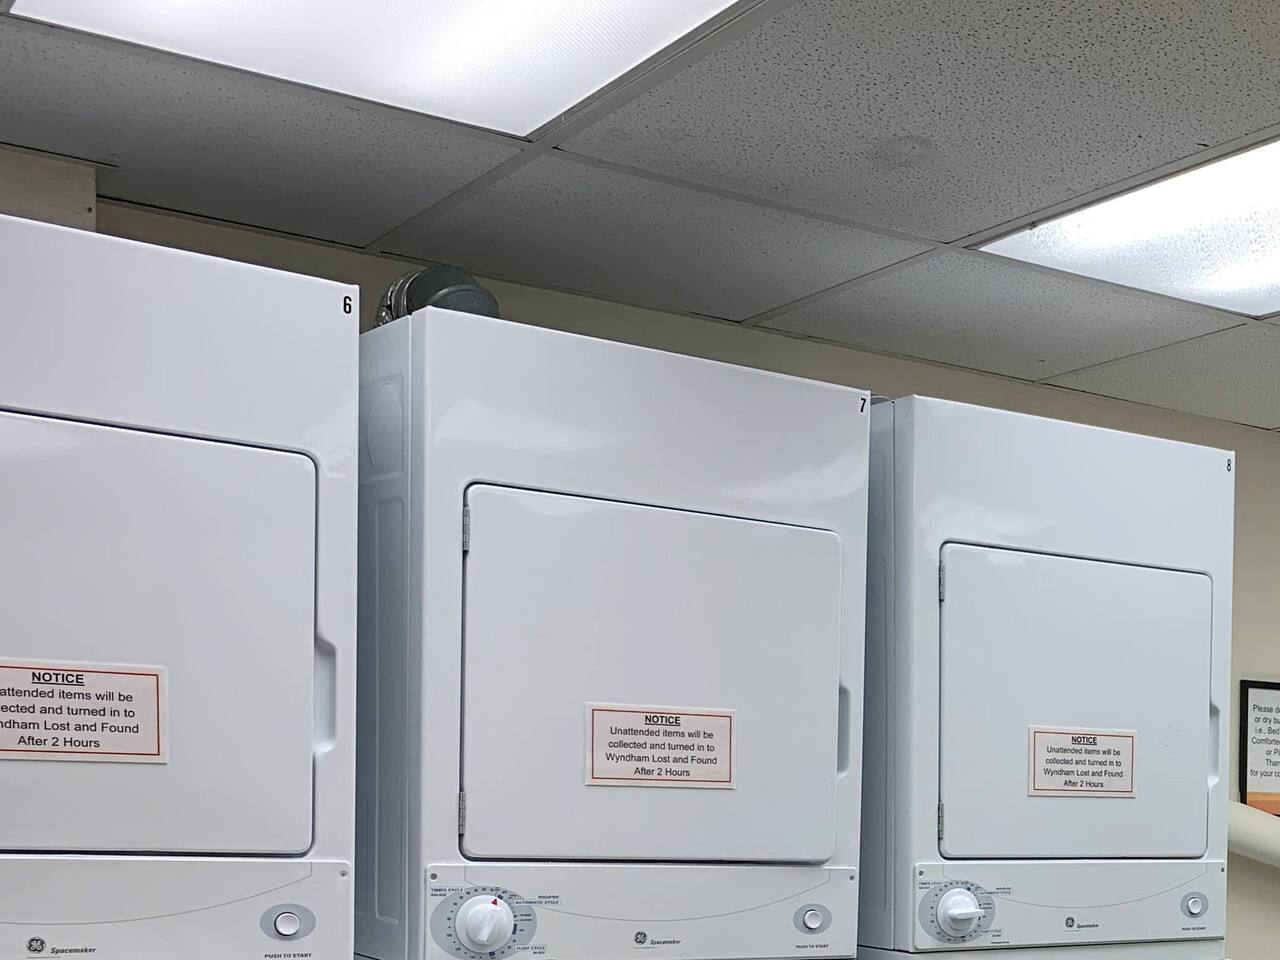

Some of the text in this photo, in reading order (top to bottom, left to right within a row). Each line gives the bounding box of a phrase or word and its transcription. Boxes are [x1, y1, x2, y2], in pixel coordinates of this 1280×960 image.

[344, 296, 352, 314] 6
[860, 397, 866, 413] 7
[1227, 458, 1231, 472] 8
[32, 672, 85, 684] NOTICE
[59, 689, 92, 700] items
[96, 692, 114, 701] will
[118, 692, 133, 702] be
[40, 706, 63, 715] and
[67, 707, 106, 716] turned
[110, 708, 120, 717] in
[124, 708, 135, 718] to
[1253, 704, 1273, 713] Please
[644, 715, 680, 724] NOTICE
[1262, 715, 1272, 725] dry
[44, 721, 70, 731] Lost
[74, 723, 97, 732] and
[101, 723, 139, 733] Found
[610, 726, 714, 739] Unattended items will be
[17, 736, 100, 748] After 2 Hours
[608, 740, 647, 749] collected
[697, 743, 704, 751] in
[1072, 736, 1097, 744] NOTICE
[1047, 746, 1082, 754] Unattended
[606, 752, 717, 764] Wyndham Lost and Found
[634, 767, 655, 776] After
[665, 768, 690, 776] Hours
[1044, 768, 1075, 776] Wyndham
[1260, 770, 1274, 779] your
